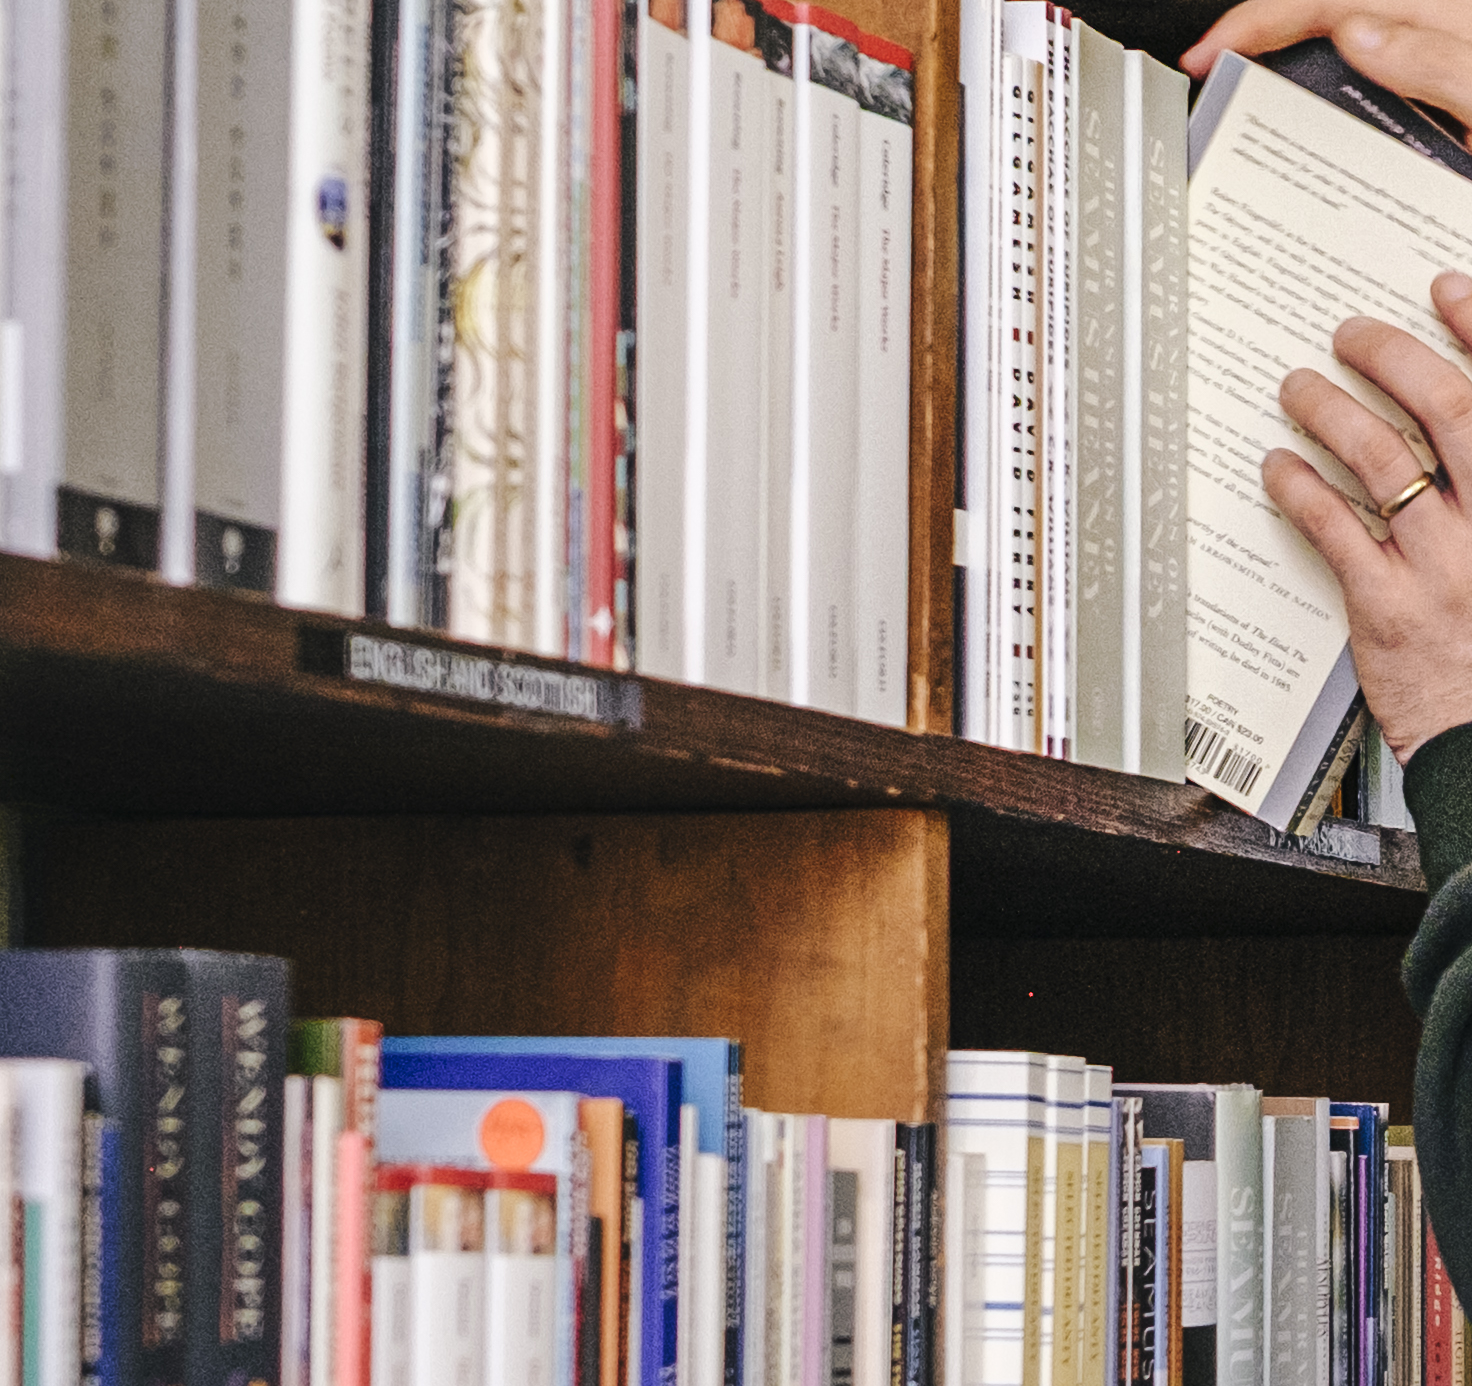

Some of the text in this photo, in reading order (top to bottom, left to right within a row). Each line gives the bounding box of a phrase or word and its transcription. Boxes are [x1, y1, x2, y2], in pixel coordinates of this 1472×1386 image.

[1146, 138, 1164, 622] SEAMUS HEANEY
[1292, 595, 1332, 622] NATION
[1229, 633, 1262, 657] Dudley
[1205, 693, 1239, 716] POETRY
[1215, 712, 1236, 729] CAN
[1235, 724, 1265, 745] $23.00
[1143, 1190, 1156, 1381] SEAMUS
